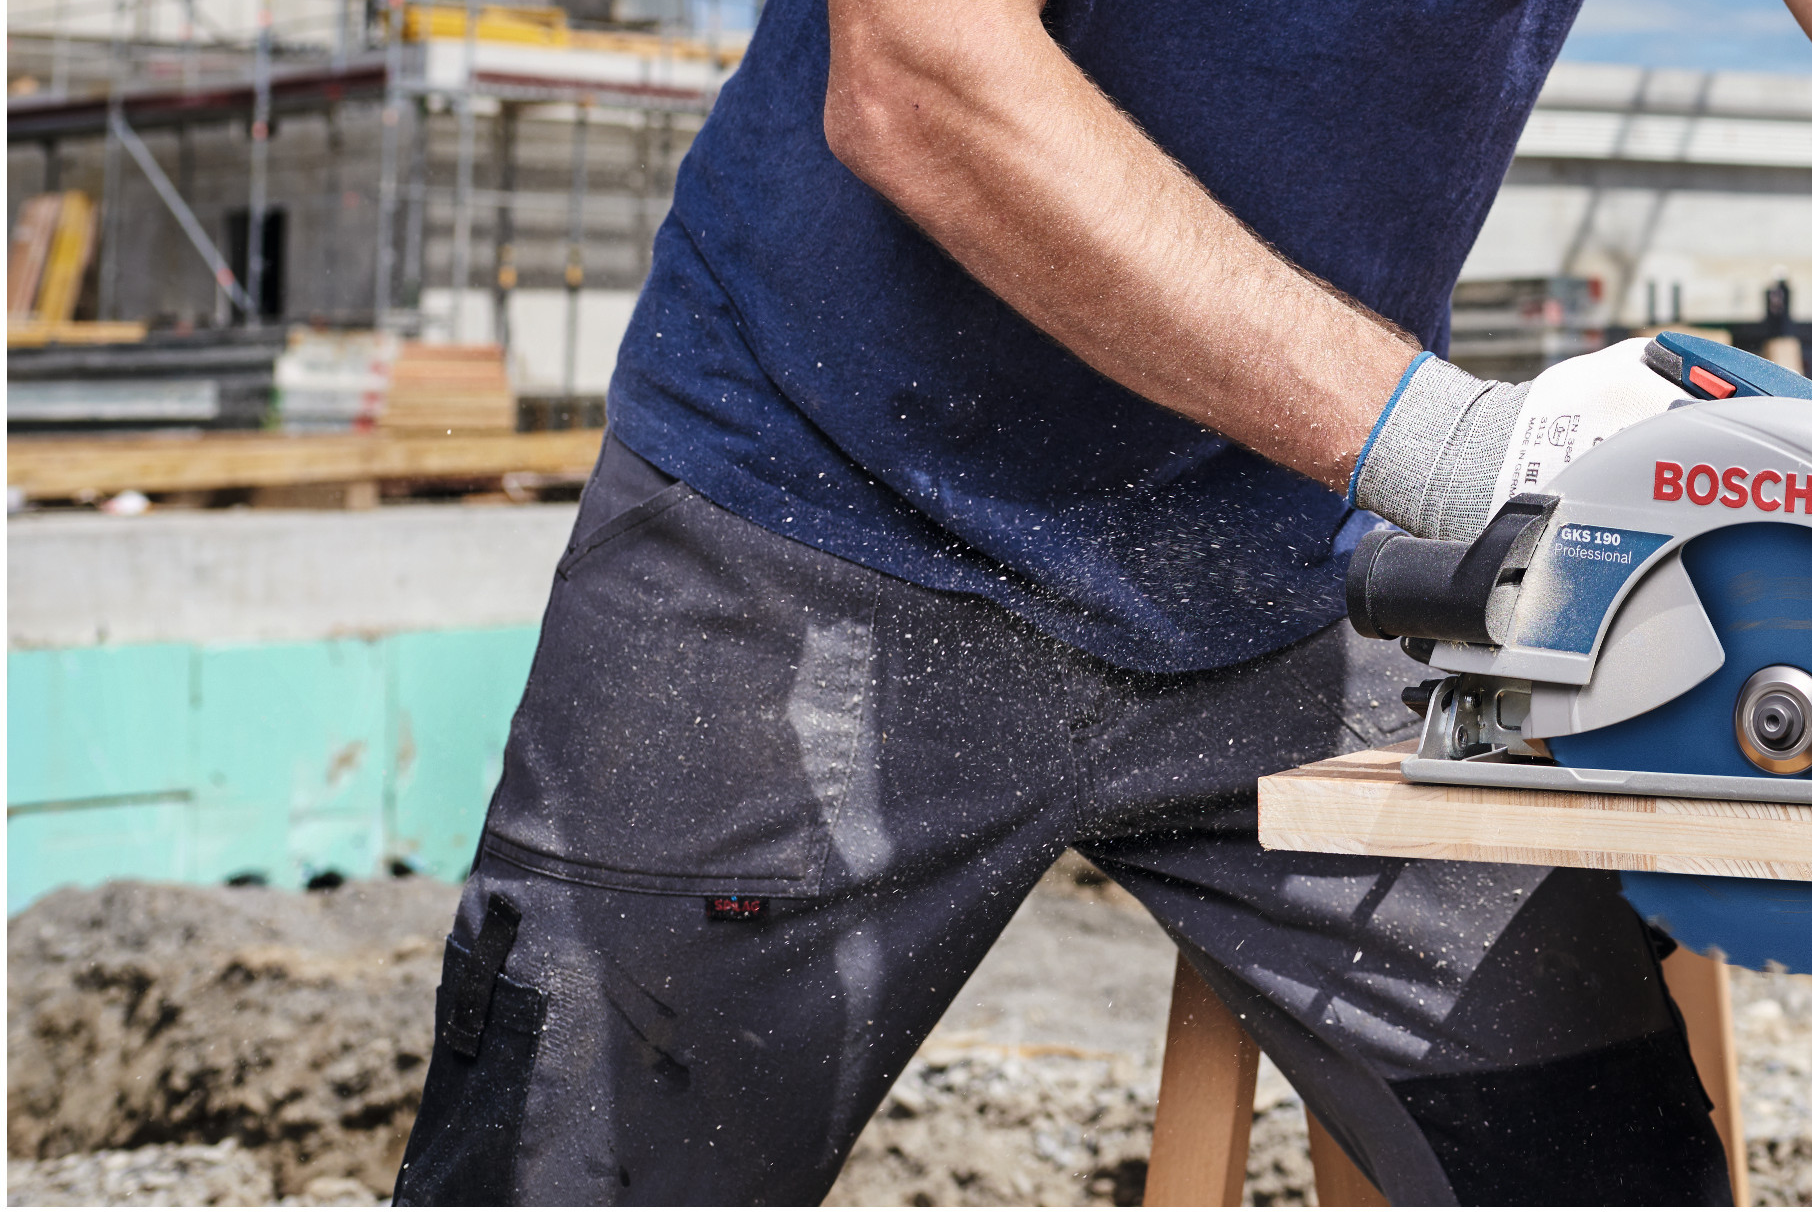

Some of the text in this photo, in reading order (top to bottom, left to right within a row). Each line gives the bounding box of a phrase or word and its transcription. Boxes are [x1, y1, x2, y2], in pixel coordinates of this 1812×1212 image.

[1522, 417, 1536, 446] MADE
[1571, 414, 1580, 433] EN
[1518, 449, 1526, 460] IN
[1561, 528, 1621, 546] GKS 190
[1554, 543, 1632, 565] Professional
